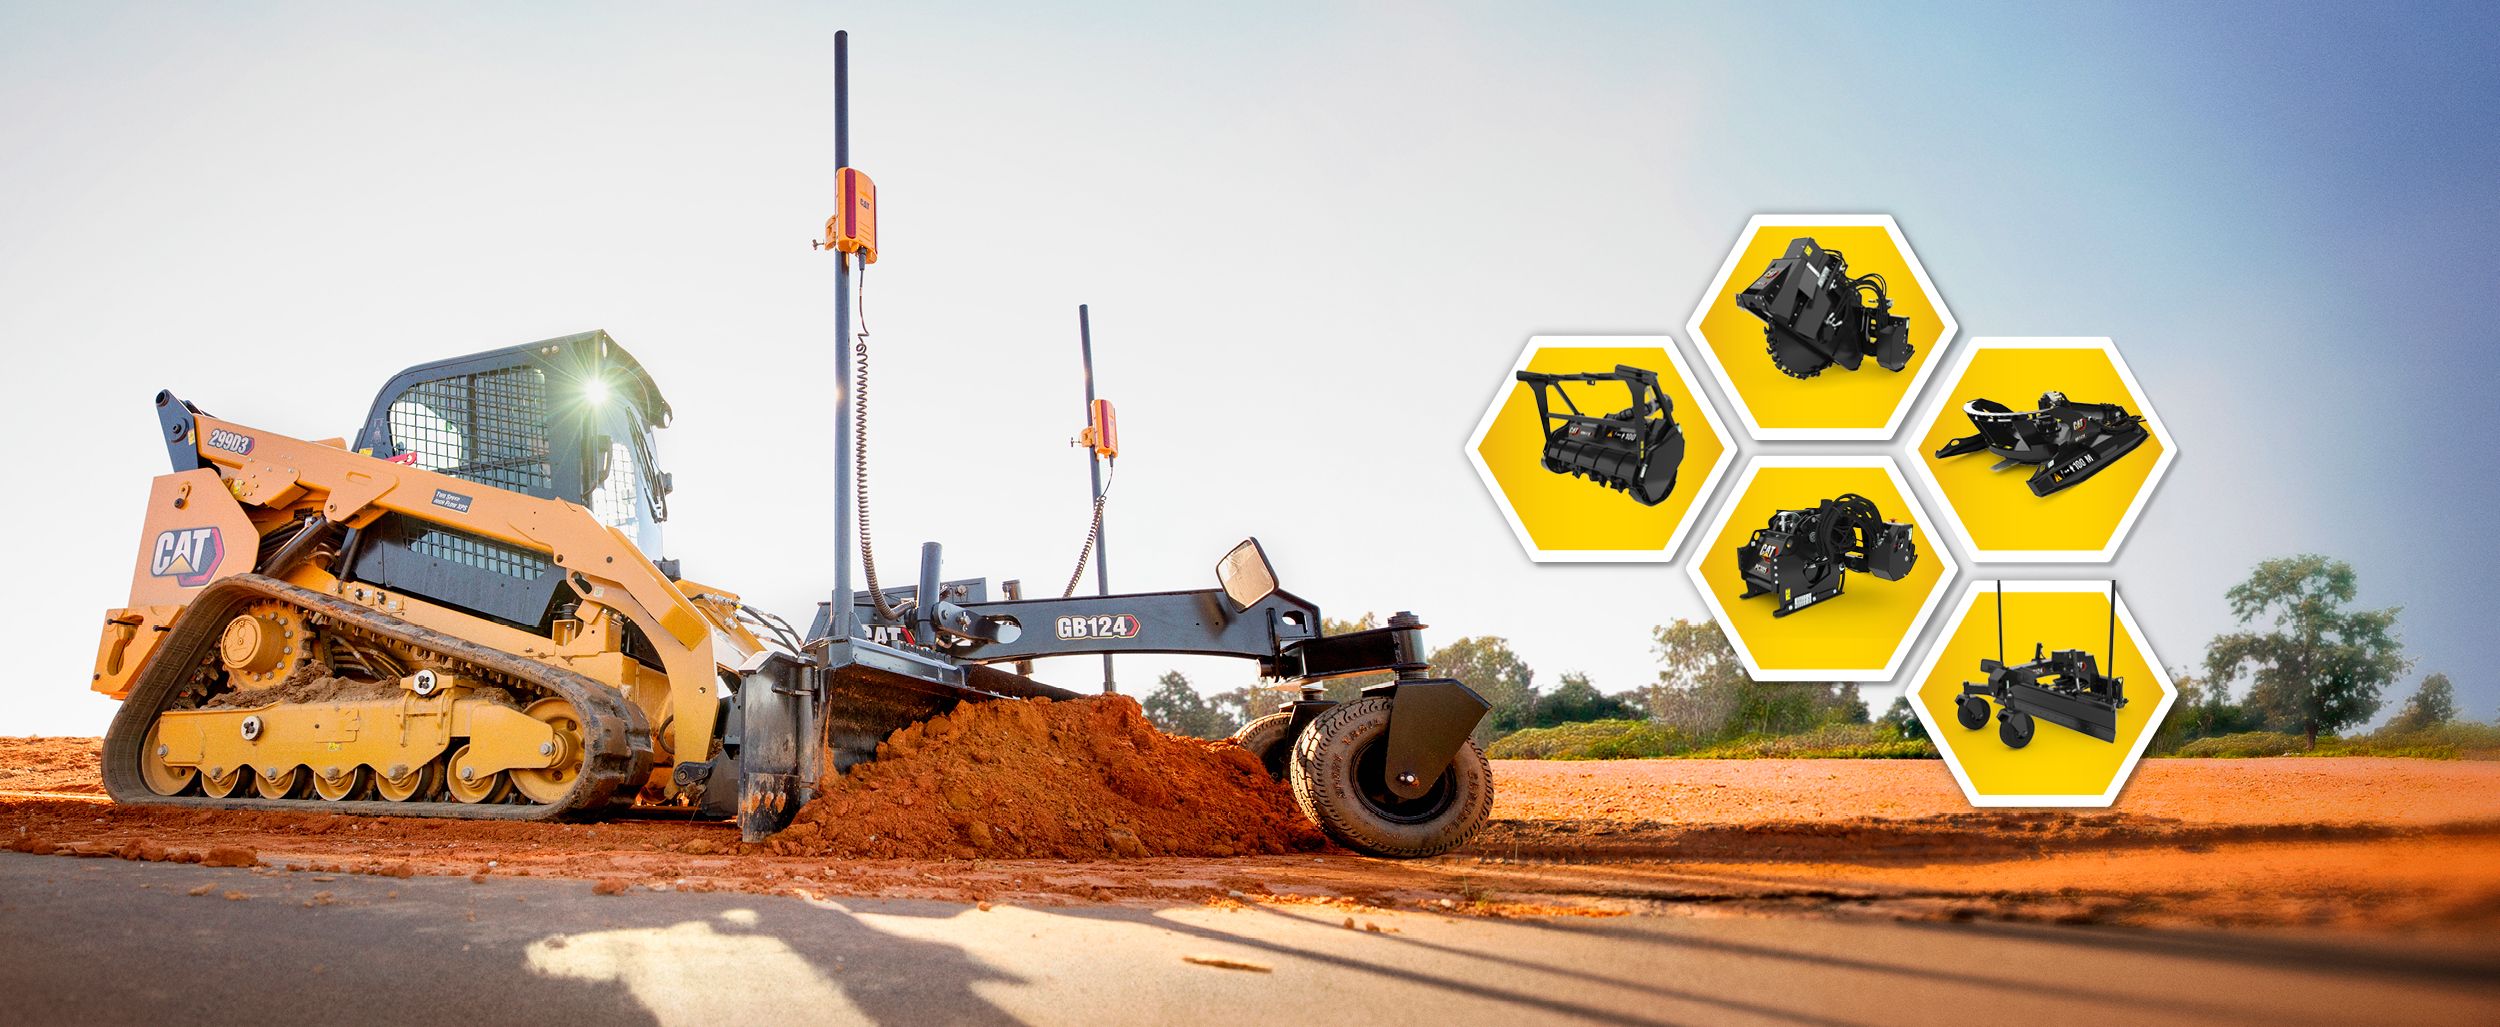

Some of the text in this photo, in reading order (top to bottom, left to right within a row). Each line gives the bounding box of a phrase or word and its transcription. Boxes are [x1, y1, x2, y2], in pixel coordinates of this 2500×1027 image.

[208, 428, 249, 454] 299D3
[152, 529, 211, 576] CAT
[1759, 543, 1776, 558] CAT
[1057, 615, 1127, 638] GB124
